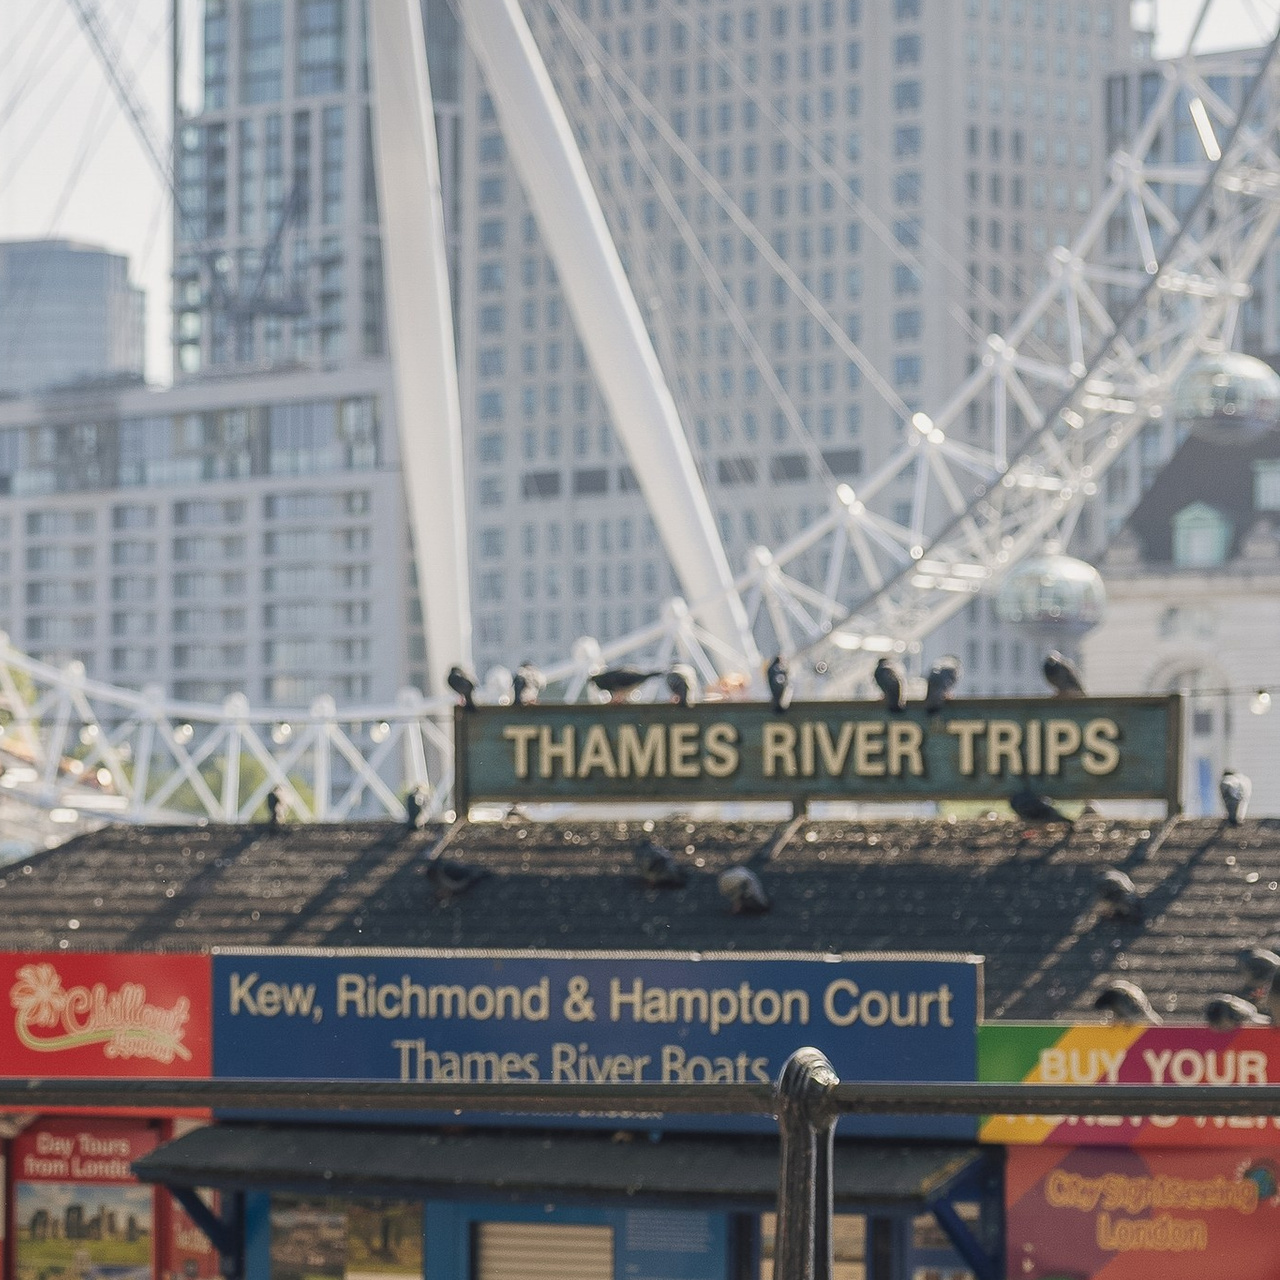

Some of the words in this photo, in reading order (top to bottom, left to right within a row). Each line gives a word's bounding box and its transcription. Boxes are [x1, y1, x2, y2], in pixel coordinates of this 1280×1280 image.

[504, 723, 738, 777] THAMES
[762, 721, 924, 777] RIVER
[948, 718, 1121, 776] TRIPS
[229, 972, 322, 1024] Kew,
[336, 973, 549, 1021] Richmond
[563, 975, 595, 1022] &
[609, 977, 810, 1035] Hampton
[824, 978, 954, 1028] Court
[392, 1038, 540, 1084] Thames
[552, 1042, 651, 1084] River
[661, 1045, 770, 1084] Boats
[1039, 1048, 1127, 1085] BUY
[1142, 1048, 1268, 1086] YOUR
[35, 1132, 75, 1156] Day
[78, 1132, 131, 1156] Tours
[23, 1156, 69, 1177] from
[71, 1156, 132, 1178] Londo
[1096, 1213, 1208, 1252] London
